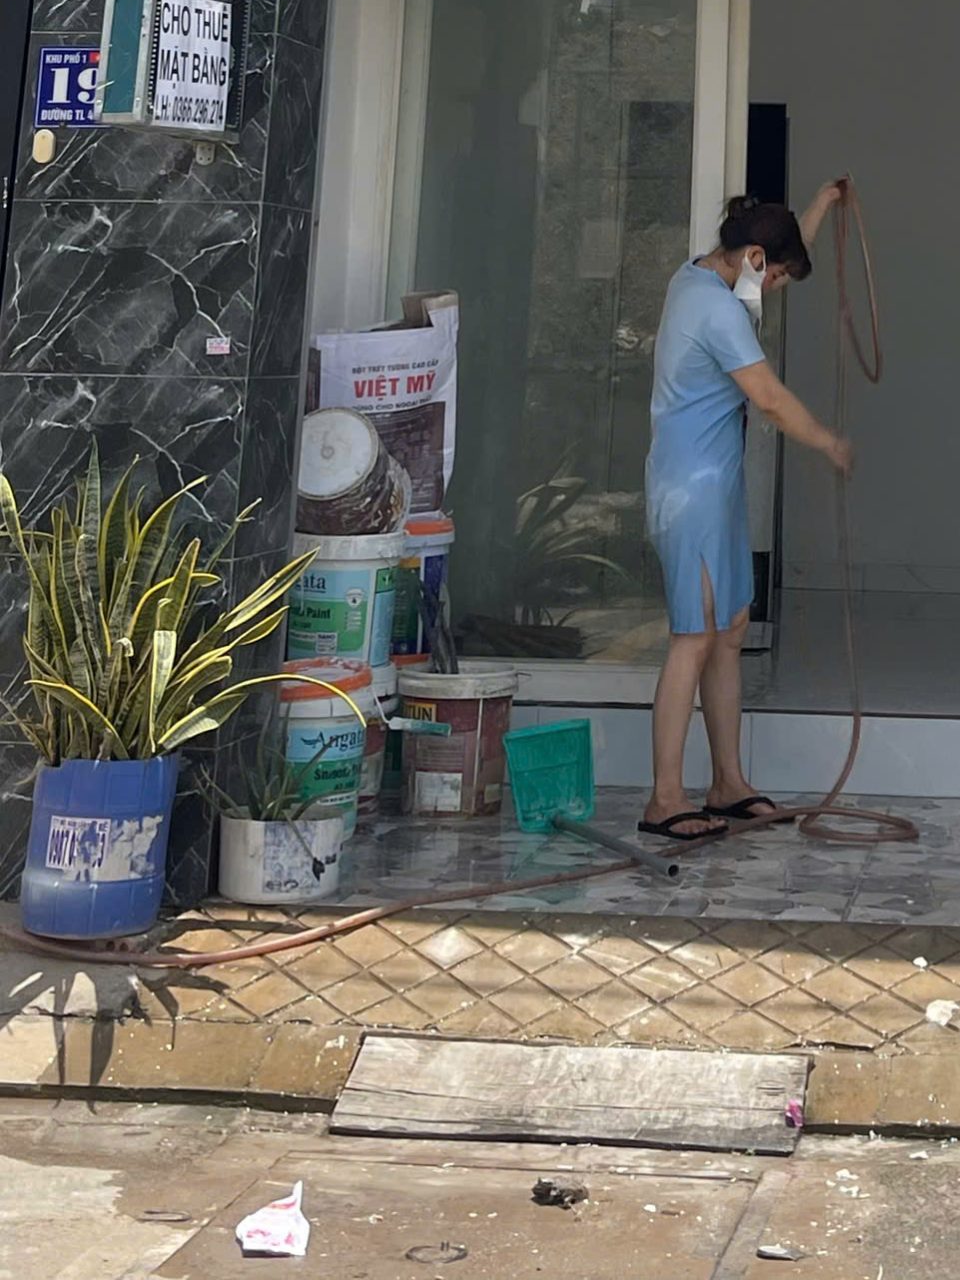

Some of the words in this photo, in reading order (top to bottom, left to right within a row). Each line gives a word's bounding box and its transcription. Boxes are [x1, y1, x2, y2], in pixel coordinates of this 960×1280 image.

[161, 2, 192, 36] CHO
[195, 5, 229, 43] THUÊ
[45, 53, 62, 64] KHU
[64, 51, 81, 64] PHỐ
[159, 45, 188, 90] MẶT
[192, 47, 227, 86] BẰNG
[41, 108, 72, 121] ĐƯỜNG
[75, 109, 86, 120] TL
[353, 374, 400, 401] VIỆT
[406, 369, 436, 394] MỸ
